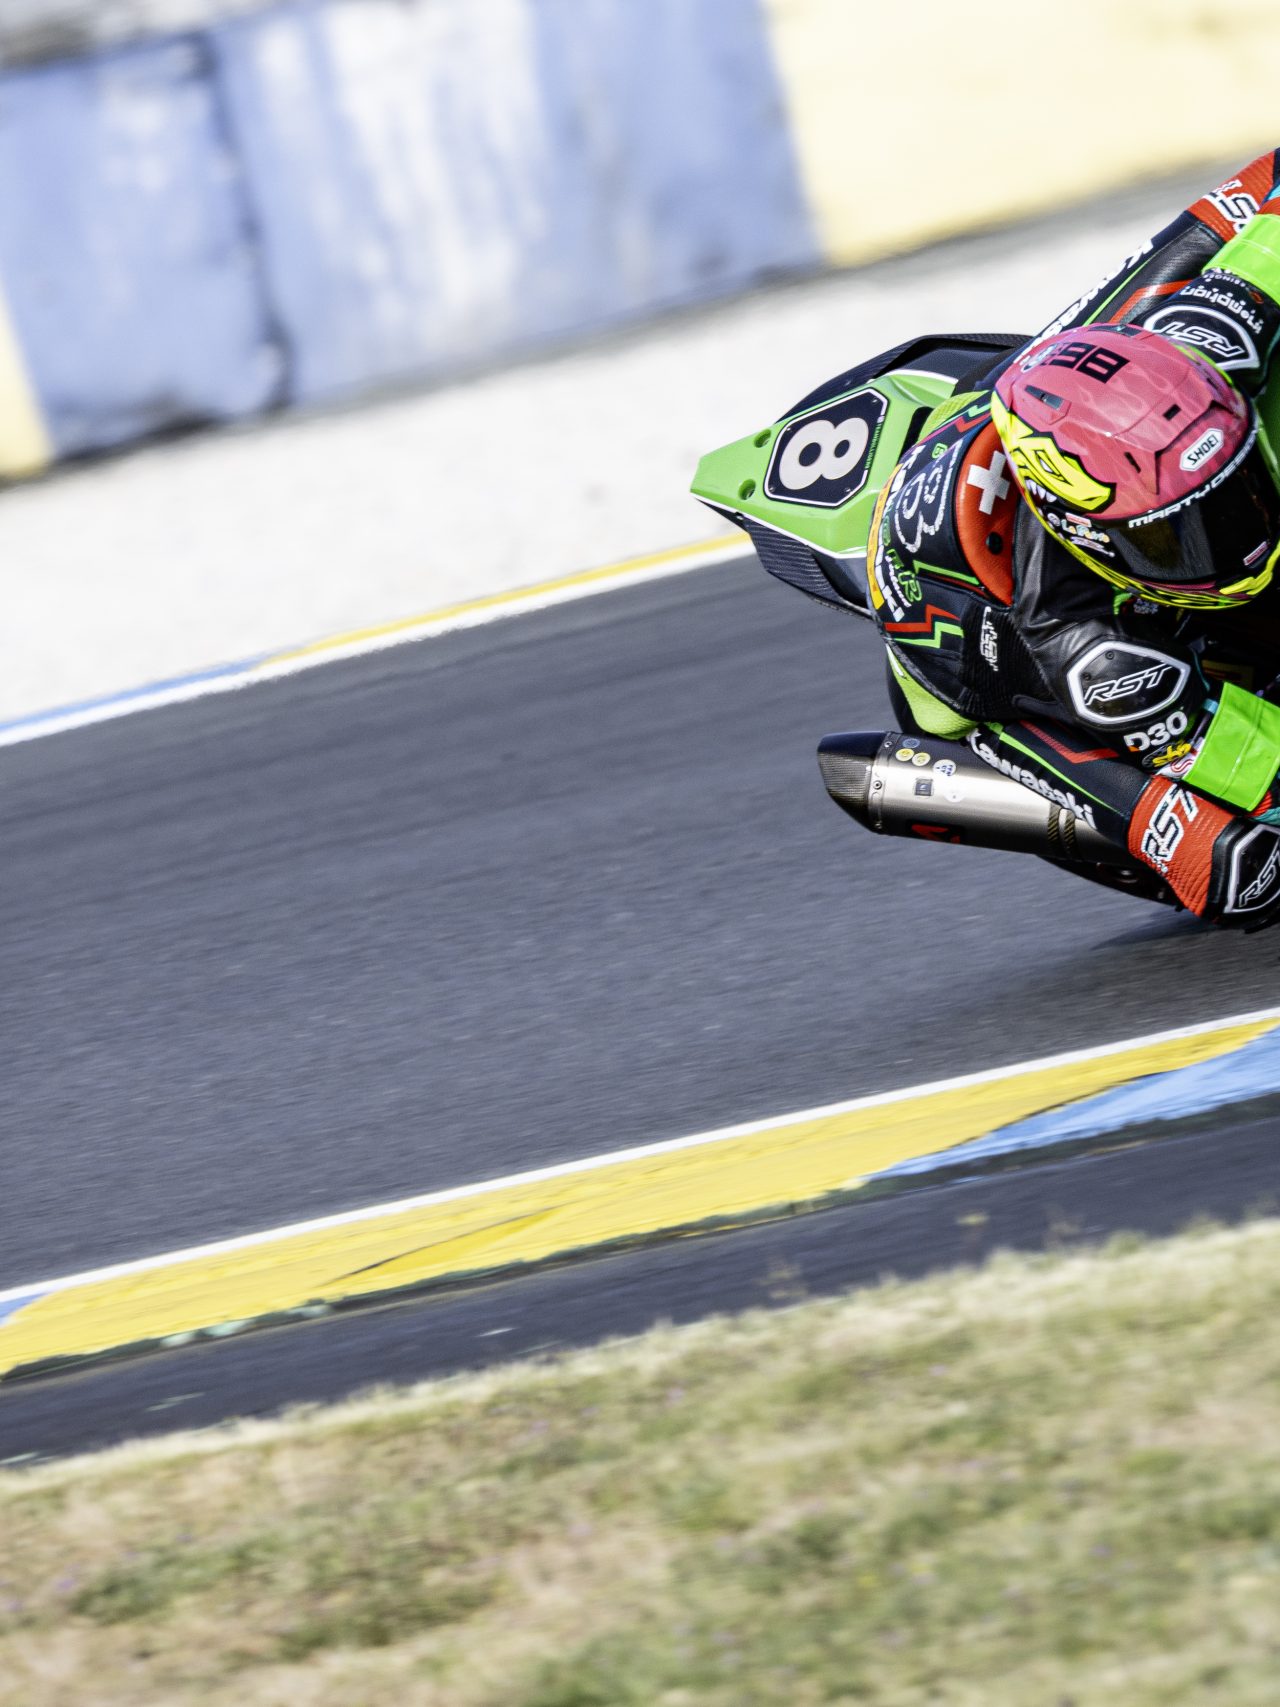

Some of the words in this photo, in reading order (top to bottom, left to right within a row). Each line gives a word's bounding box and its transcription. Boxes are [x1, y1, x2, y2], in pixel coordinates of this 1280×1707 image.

[779, 417, 869, 490] 8
[1187, 435, 1220, 466] SHOEI
[1084, 663, 1173, 706] RST
[1141, 783, 1199, 868] RST
